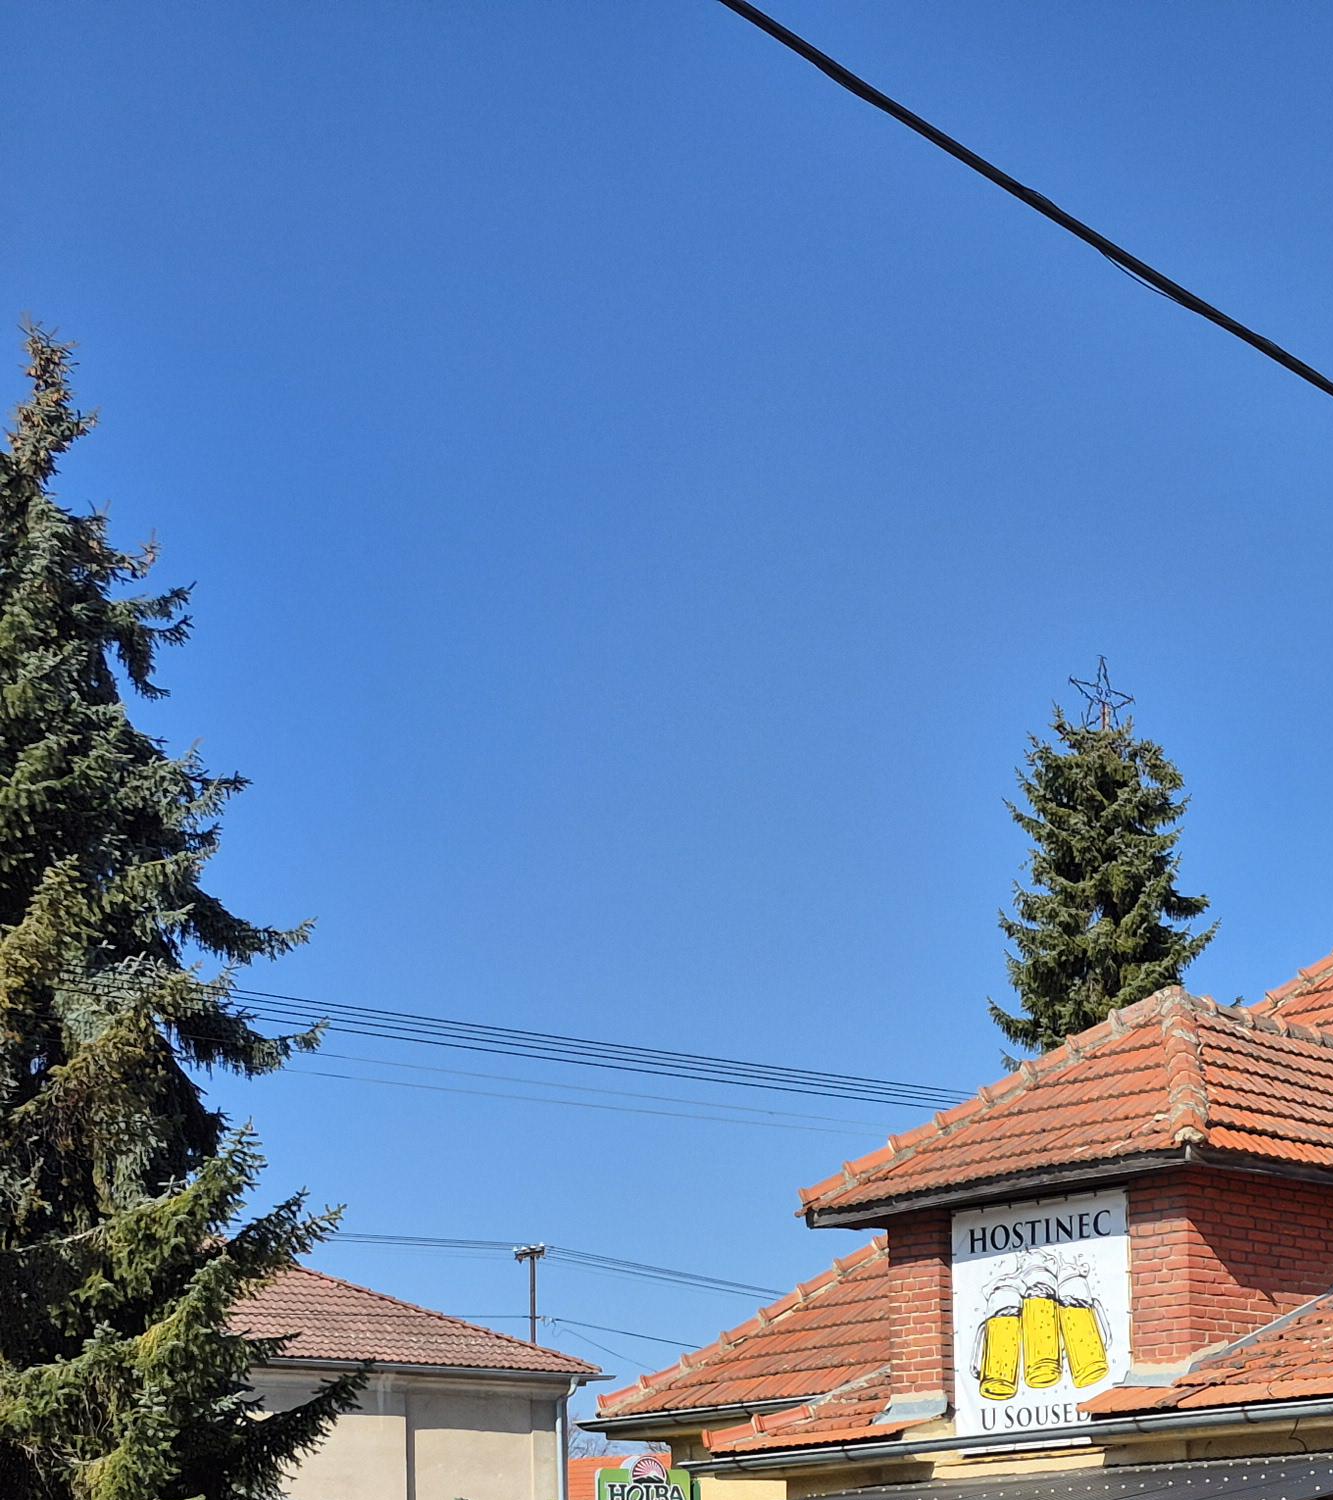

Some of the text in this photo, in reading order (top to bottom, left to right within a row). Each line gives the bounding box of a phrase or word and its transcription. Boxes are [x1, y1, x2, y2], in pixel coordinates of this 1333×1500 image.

[969, 1209, 1111, 1254] HOSTINEC
[981, 1402, 1091, 1431] U SOUSED
